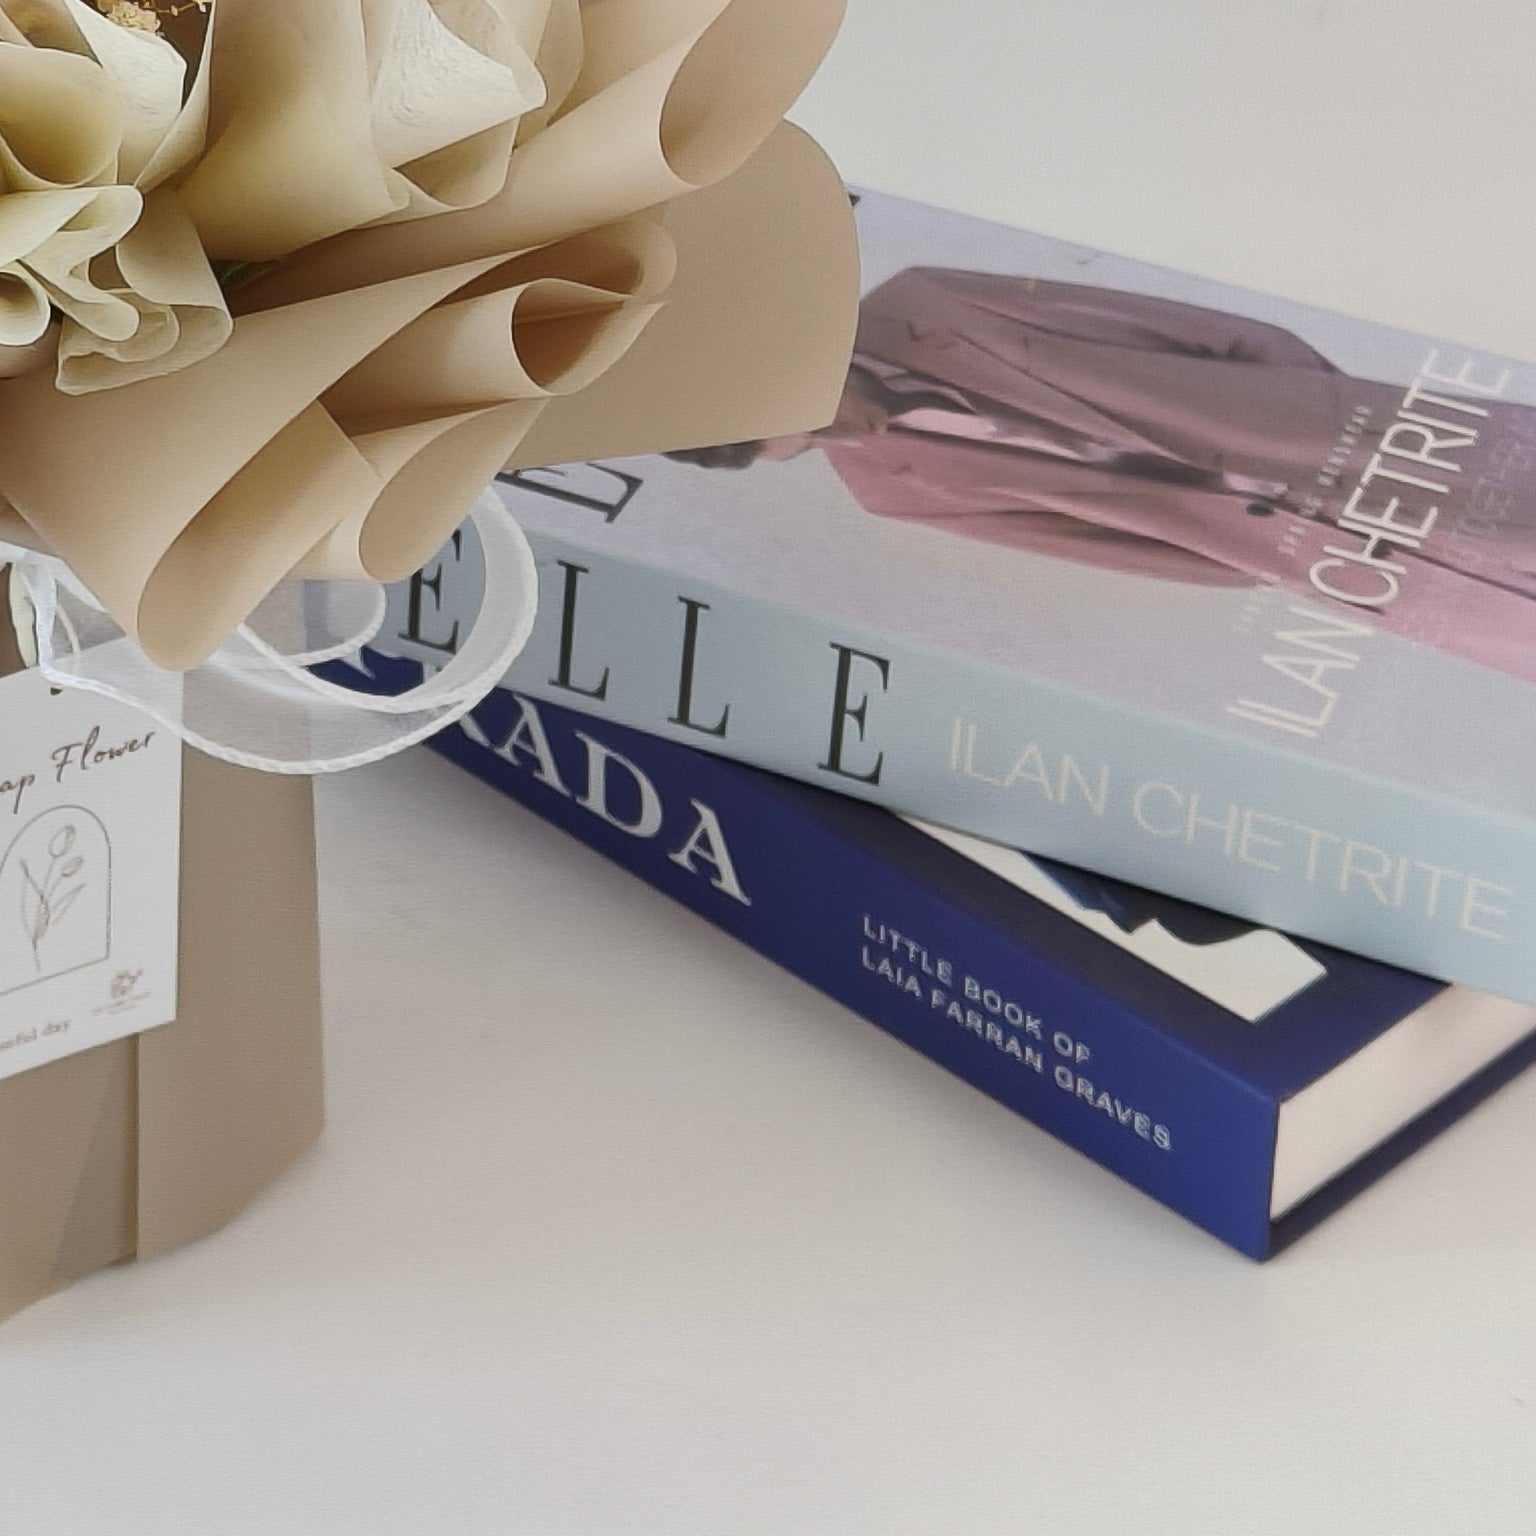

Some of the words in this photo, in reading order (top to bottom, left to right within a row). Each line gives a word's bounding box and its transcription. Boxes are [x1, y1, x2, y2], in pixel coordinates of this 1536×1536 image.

[1225, 606, 1373, 737] ILAN
[1309, 349, 1511, 606] CHETRITE
[51, 725, 156, 784] Flower
[397, 528, 890, 787] ELLE
[948, 718, 1110, 818] ILAN
[1132, 780, 1515, 942] CHETRITE
[863, 945, 923, 999] LAIA
[930, 988, 1044, 1073] FARRAN
[1054, 1064, 1172, 1151] GRAVES
[864, 914, 952, 987] LITTLE
[964, 974, 1043, 1040] BOOK
[1053, 1031, 1091, 1064] OF
